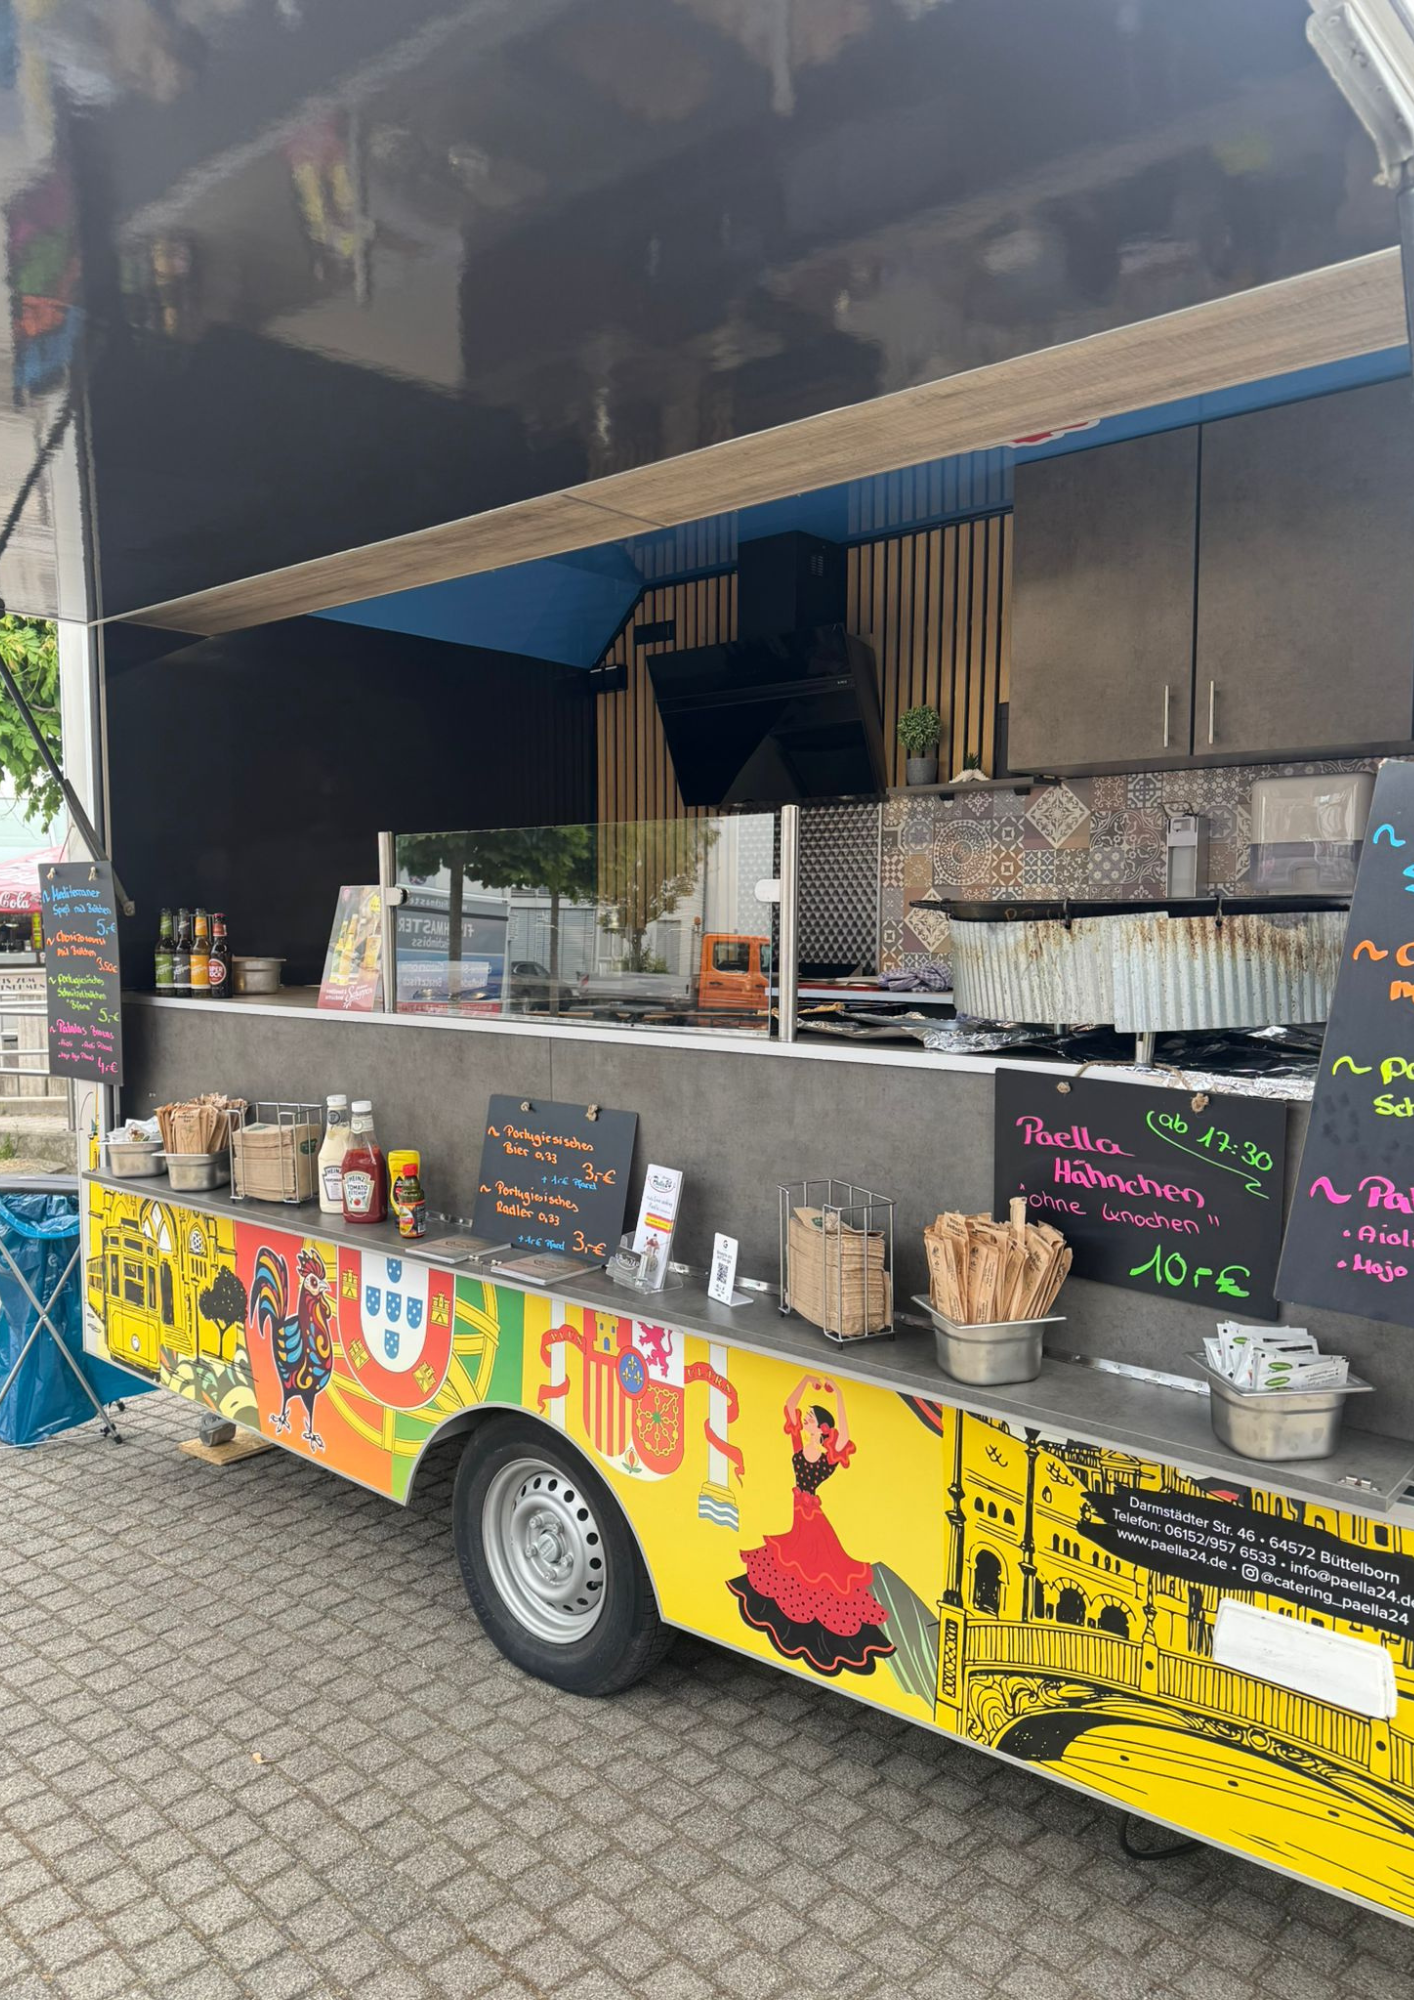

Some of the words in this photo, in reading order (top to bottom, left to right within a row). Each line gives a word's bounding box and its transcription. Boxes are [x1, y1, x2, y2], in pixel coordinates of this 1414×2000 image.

[503, 1141, 530, 1157] Bier
[1016, 1116, 1136, 1157] Paella
[1196, 1126, 1273, 1171] 17:30
[496, 1201, 534, 1218] Radler
[1054, 1157, 1205, 1208] Hähnchen
[1113, 1508, 1162, 1533] Telefon:
[1164, 1523, 1236, 1555] 06152/957
[1239, 1545, 1276, 1567] 6533
[1129, 1496, 1210, 1530] Darmstädter
[1212, 1520, 1233, 1537] Str.
[1237, 1528, 1255, 1542] 46
[1269, 1537, 1316, 1560] 64572
[1320, 1551, 1400, 1585] Büttelborn
[1117, 1528, 1228, 1570] www.paella24.de
[1261, 1572, 1409, 1626] @catering_paella24
